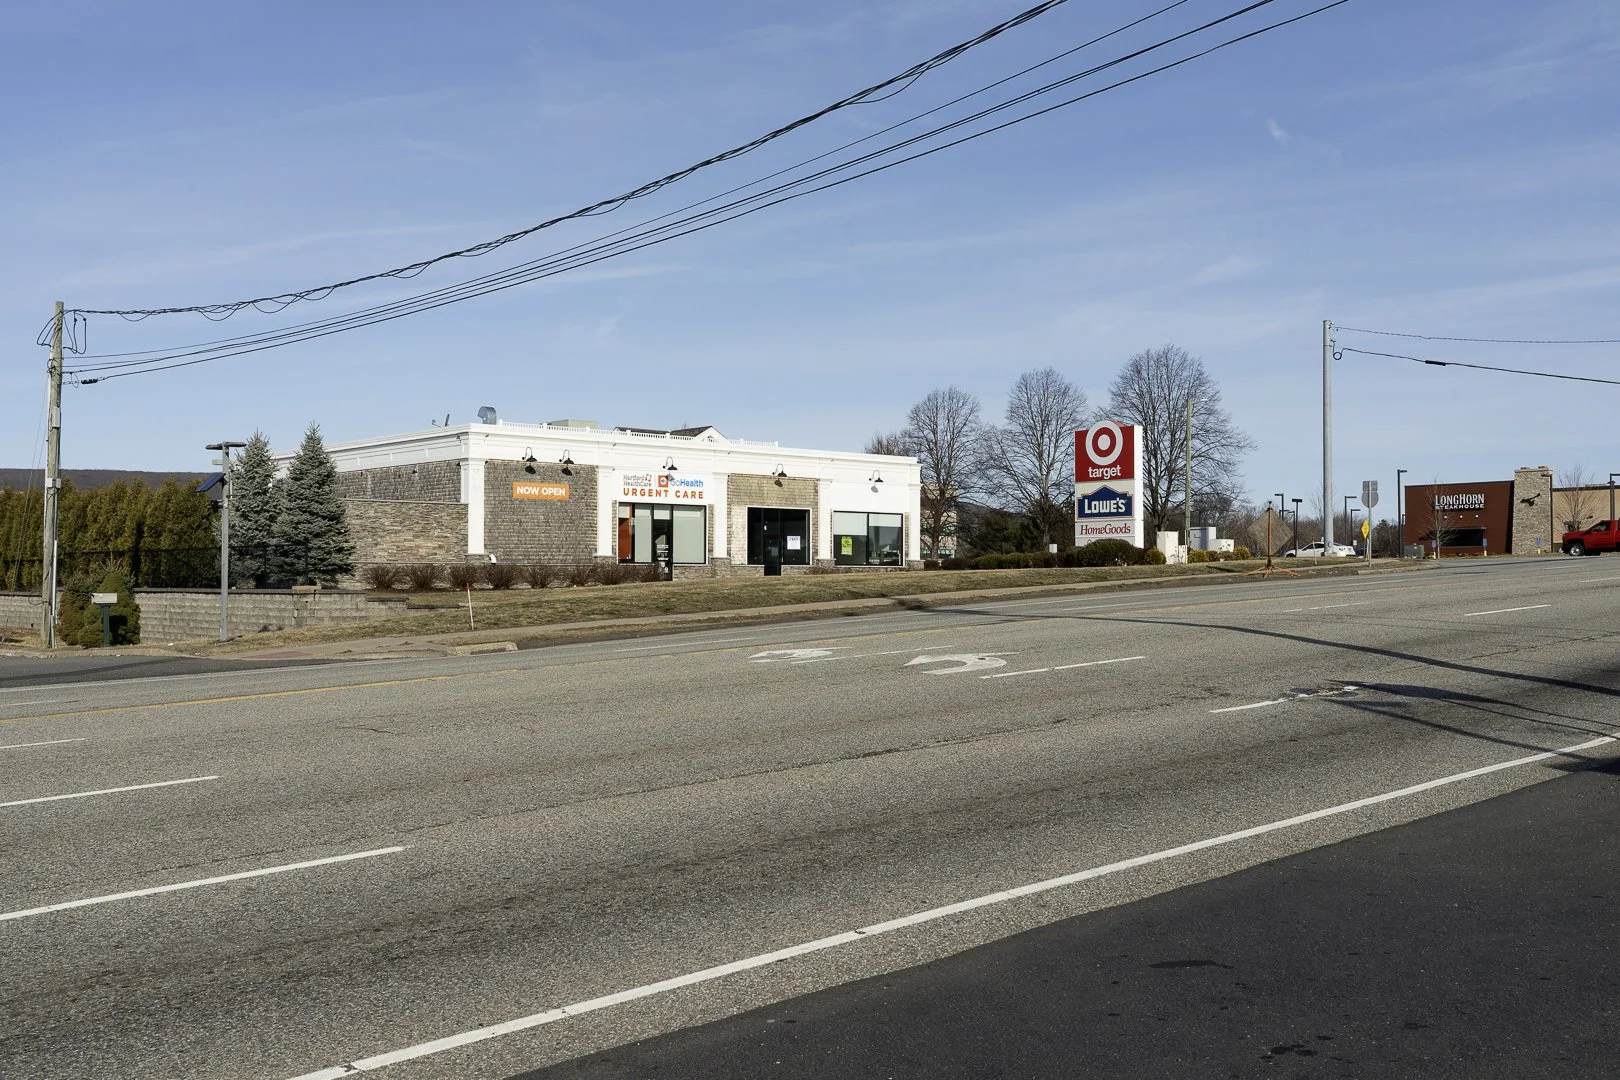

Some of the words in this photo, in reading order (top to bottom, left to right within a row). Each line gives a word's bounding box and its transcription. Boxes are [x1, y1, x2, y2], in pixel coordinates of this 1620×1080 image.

[1088, 465, 1121, 479] target
[516, 486, 540, 495] NOW
[541, 487, 566, 496] OPEN
[623, 488, 669, 497] URGENT
[675, 490, 704, 499] CARE
[1435, 494, 1485, 505] LONGHORN
[1084, 498, 1126, 514] LOWE'S
[1080, 523, 1131, 535] HomeGoods
